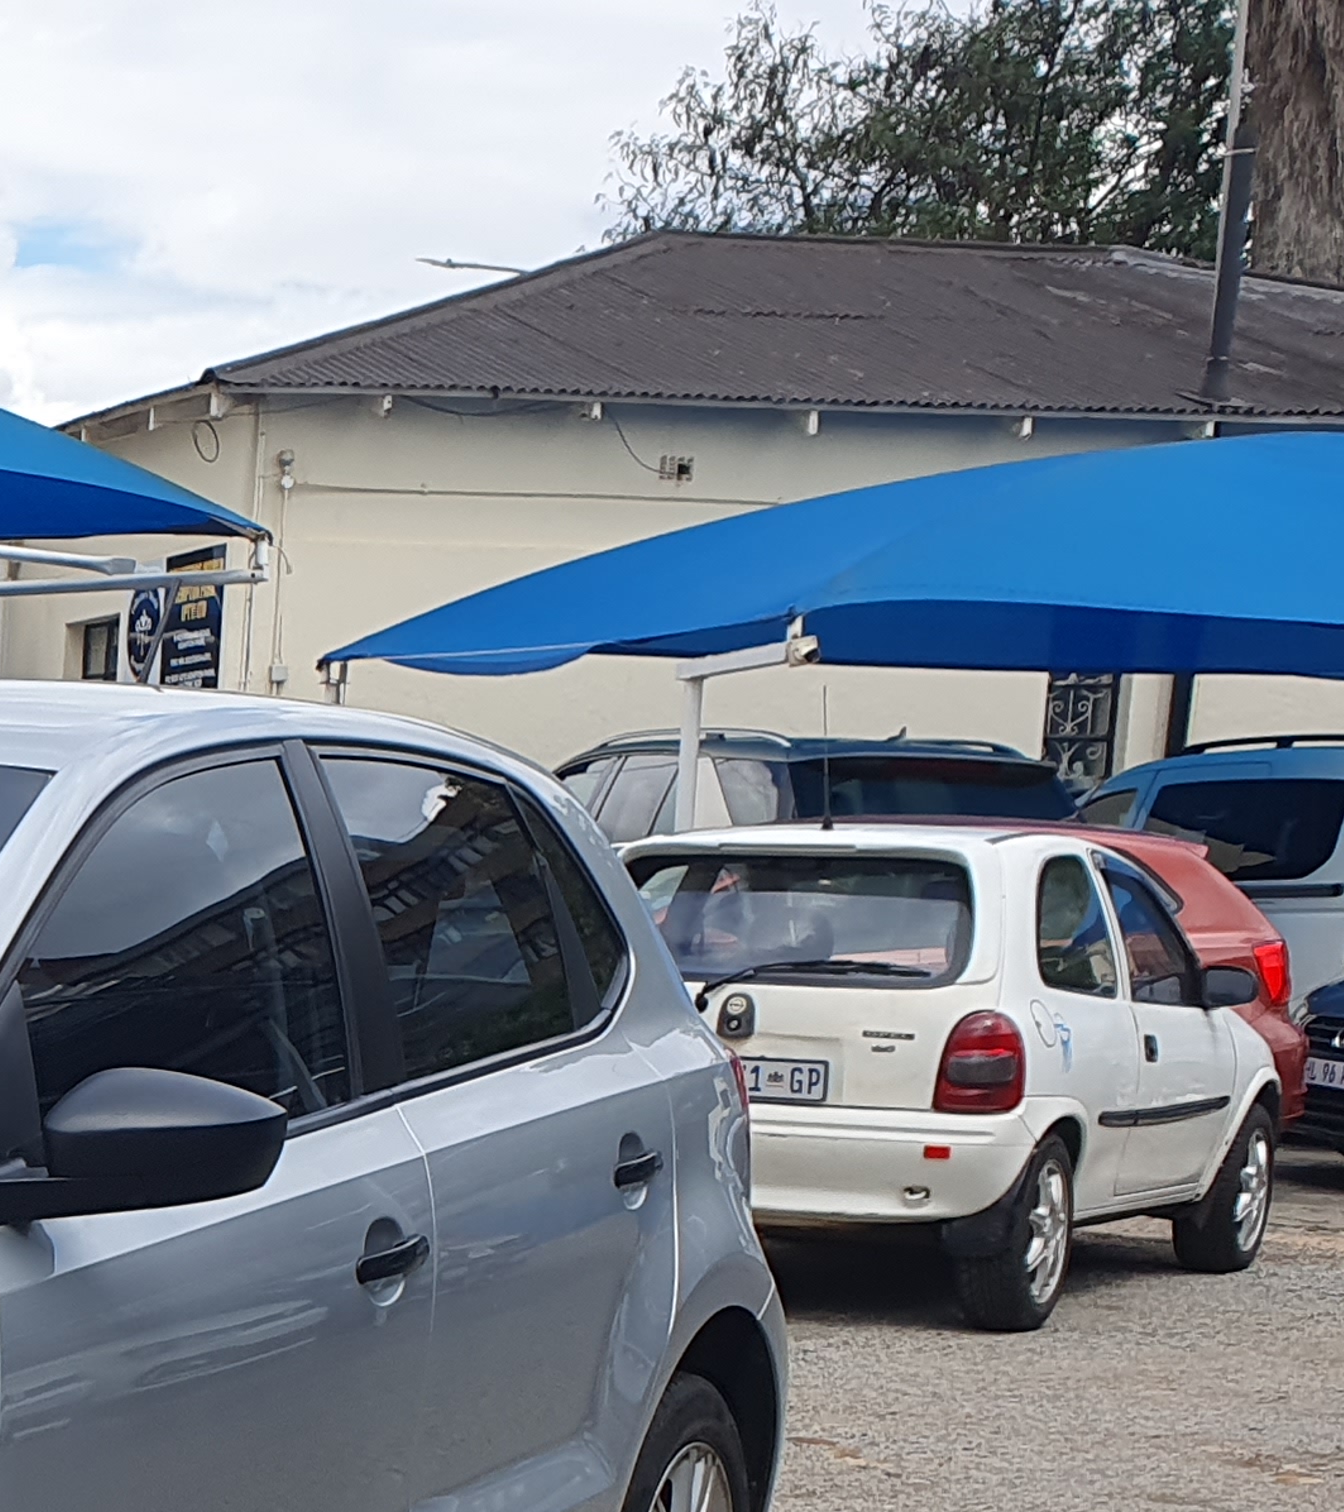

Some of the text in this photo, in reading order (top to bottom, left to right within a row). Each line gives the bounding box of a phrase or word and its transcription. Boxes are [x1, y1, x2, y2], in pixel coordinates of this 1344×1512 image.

[742, 1064, 822, 1095] 1 GP
[1322, 1062, 1337, 1083] 96
